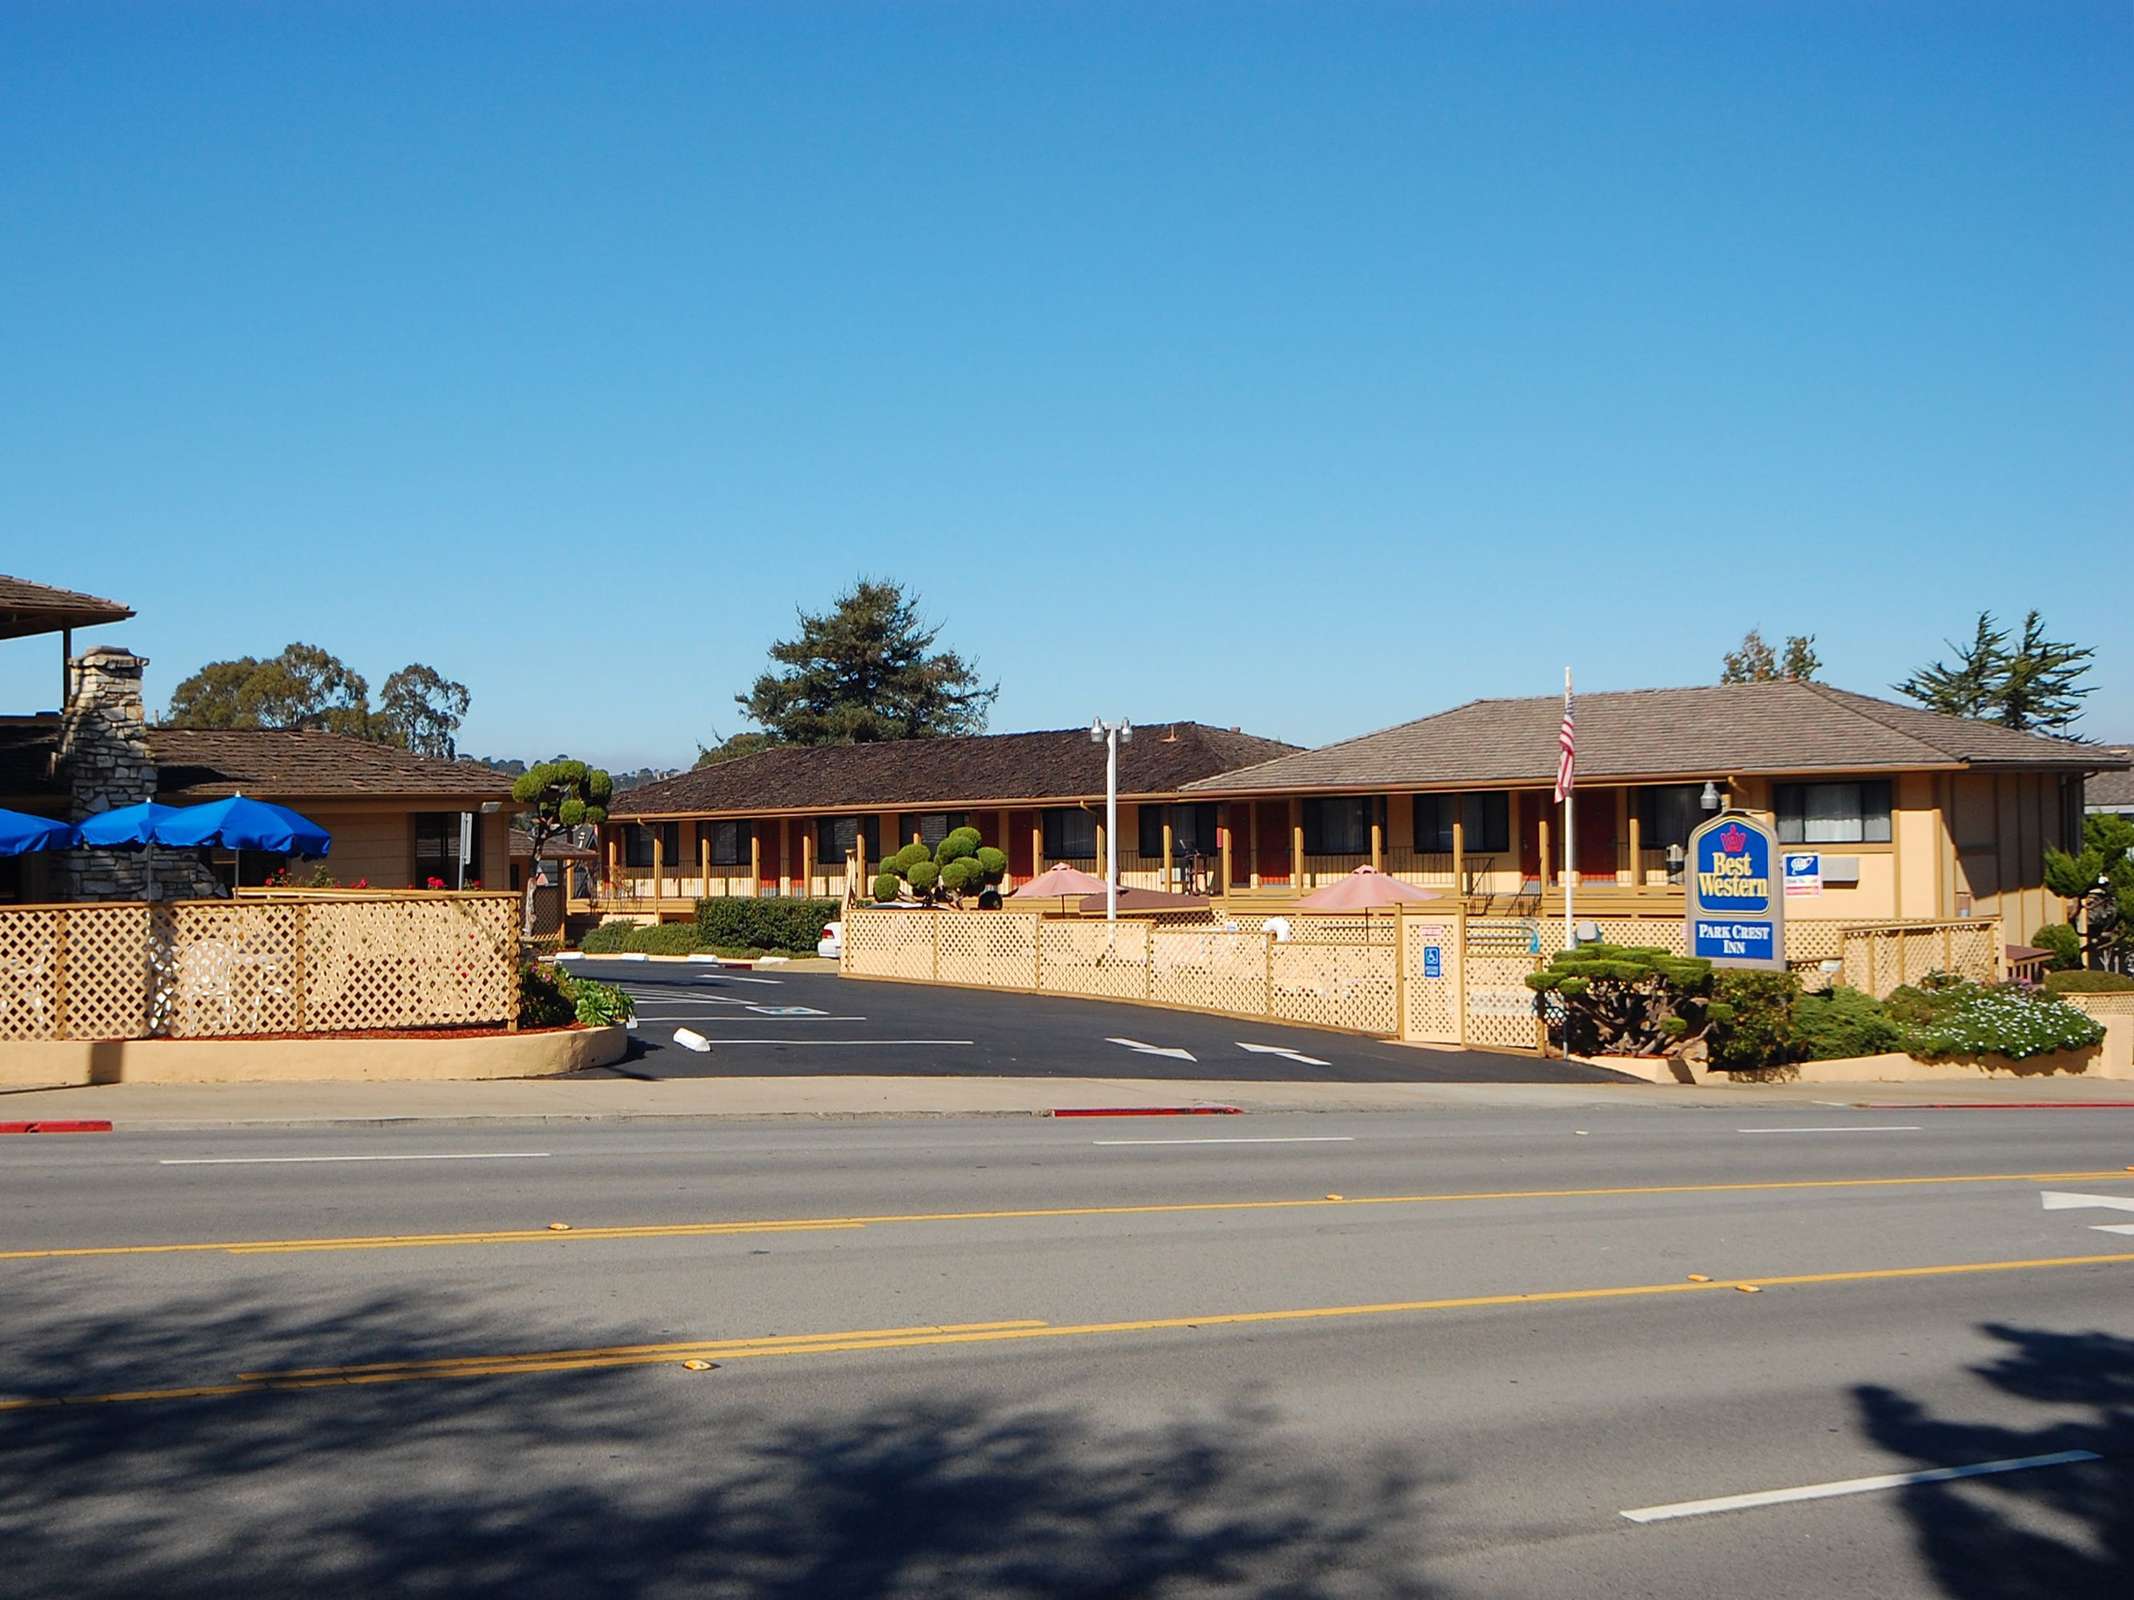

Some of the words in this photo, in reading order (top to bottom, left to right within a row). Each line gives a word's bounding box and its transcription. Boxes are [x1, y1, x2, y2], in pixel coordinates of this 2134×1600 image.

[1712, 852, 1752, 876] Best
[1699, 872, 1769, 897] Western
[1699, 924, 1731, 939] PARK
[1732, 924, 1769, 939] CREST
[1723, 940, 1745, 954] INN
